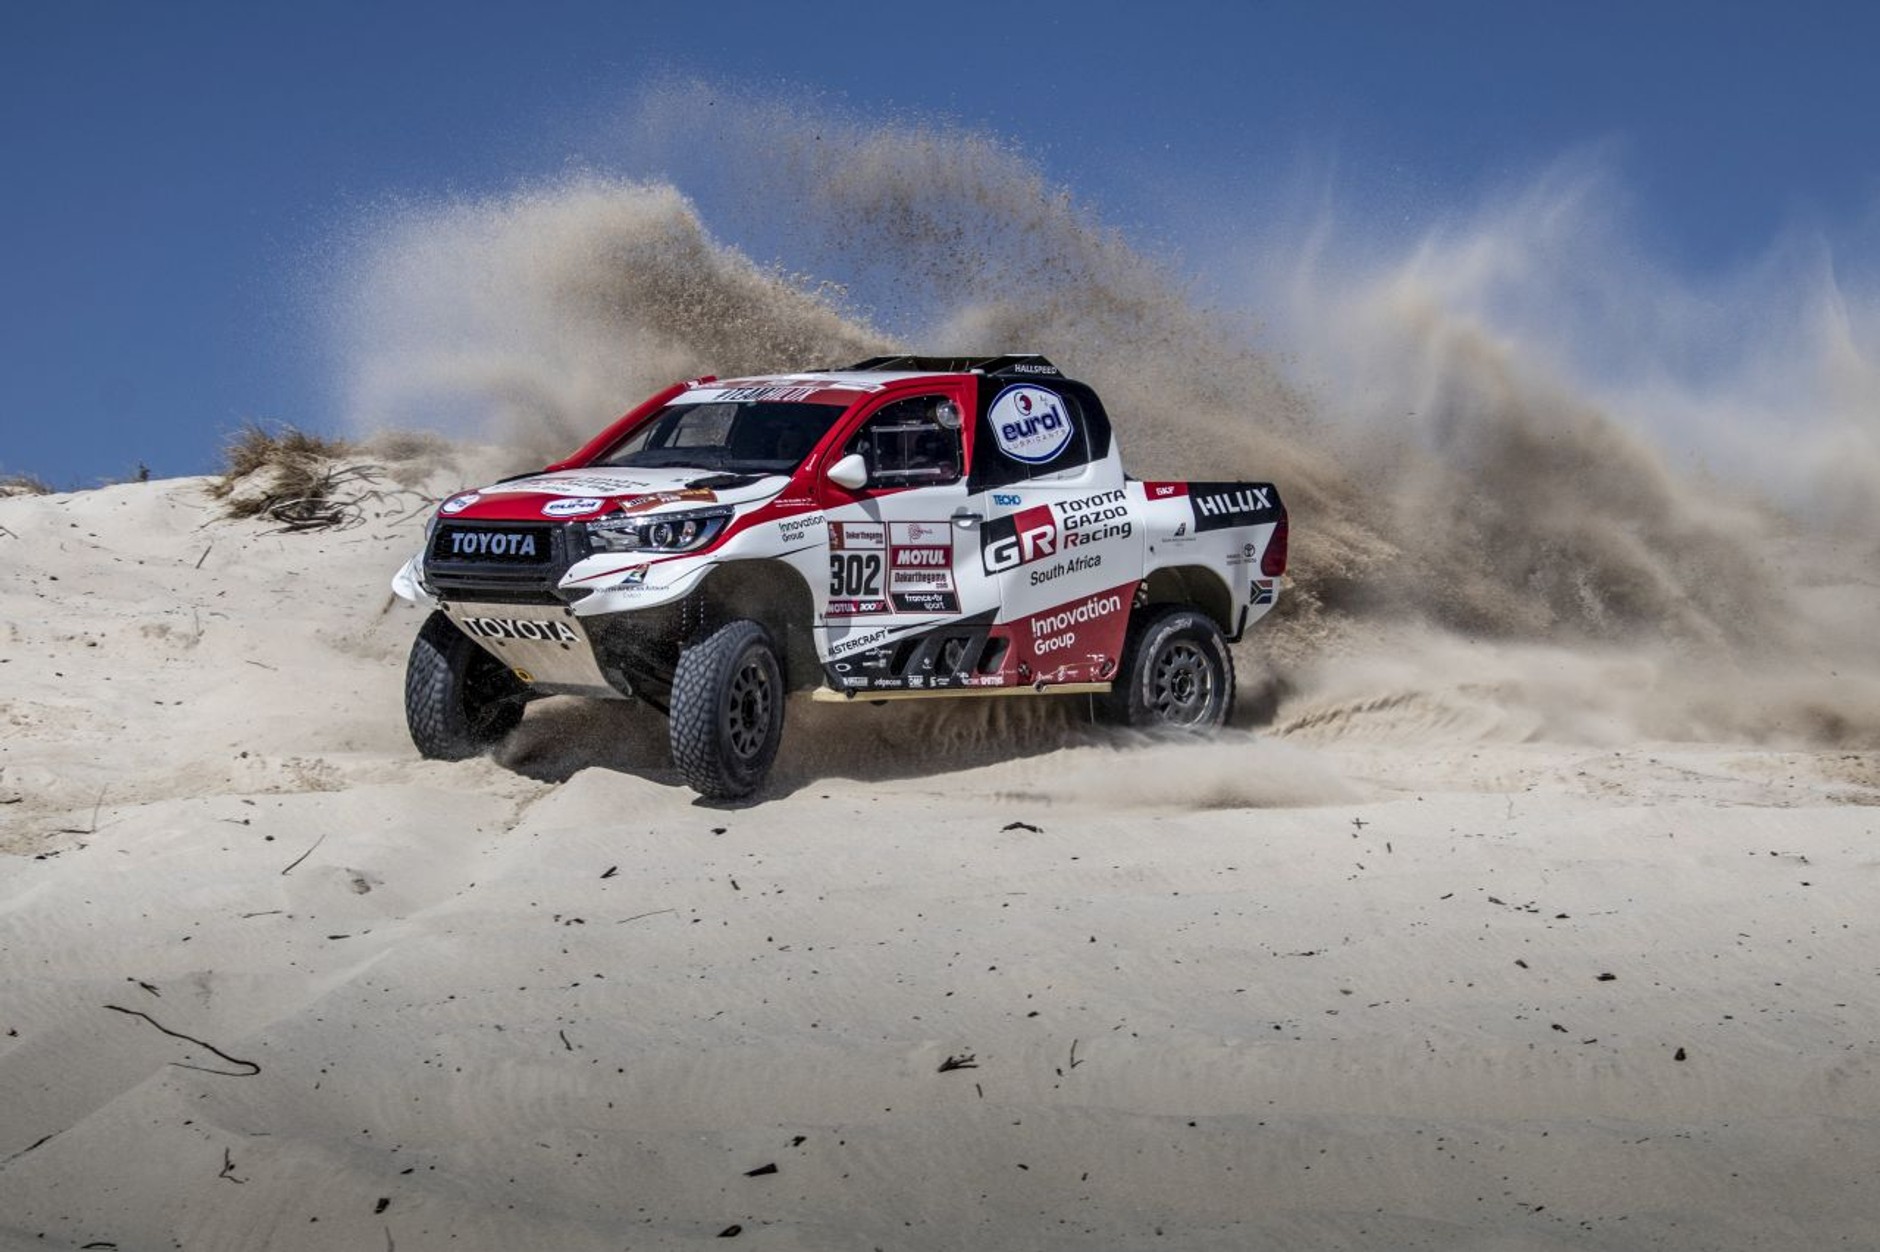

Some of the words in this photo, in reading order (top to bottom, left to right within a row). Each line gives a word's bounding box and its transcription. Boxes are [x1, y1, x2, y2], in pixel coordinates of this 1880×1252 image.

[1014, 364, 1057, 374] HALLSPEED
[1002, 404, 1062, 442] eurol
[1055, 489, 1127, 514] TOYOTA
[1155, 486, 1175, 496] SKF
[1196, 487, 1272, 516] HILUX
[779, 514, 826, 532] Innovation
[1063, 505, 1128, 531] GAZOO
[452, 532, 536, 556] TOYOTA
[781, 531, 805, 542] Group
[1063, 522, 1132, 549] Racing
[897, 549, 946, 565] MOTUL
[984, 525, 1055, 572] GR
[830, 554, 881, 596] 302
[895, 572, 947, 584] Dakarthegame
[1030, 563, 1065, 586] South
[1066, 554, 1102, 575] Africa
[1031, 596, 1121, 638] Innovation
[460, 617, 581, 643] TOYOTA
[1034, 632, 1075, 655] Group
